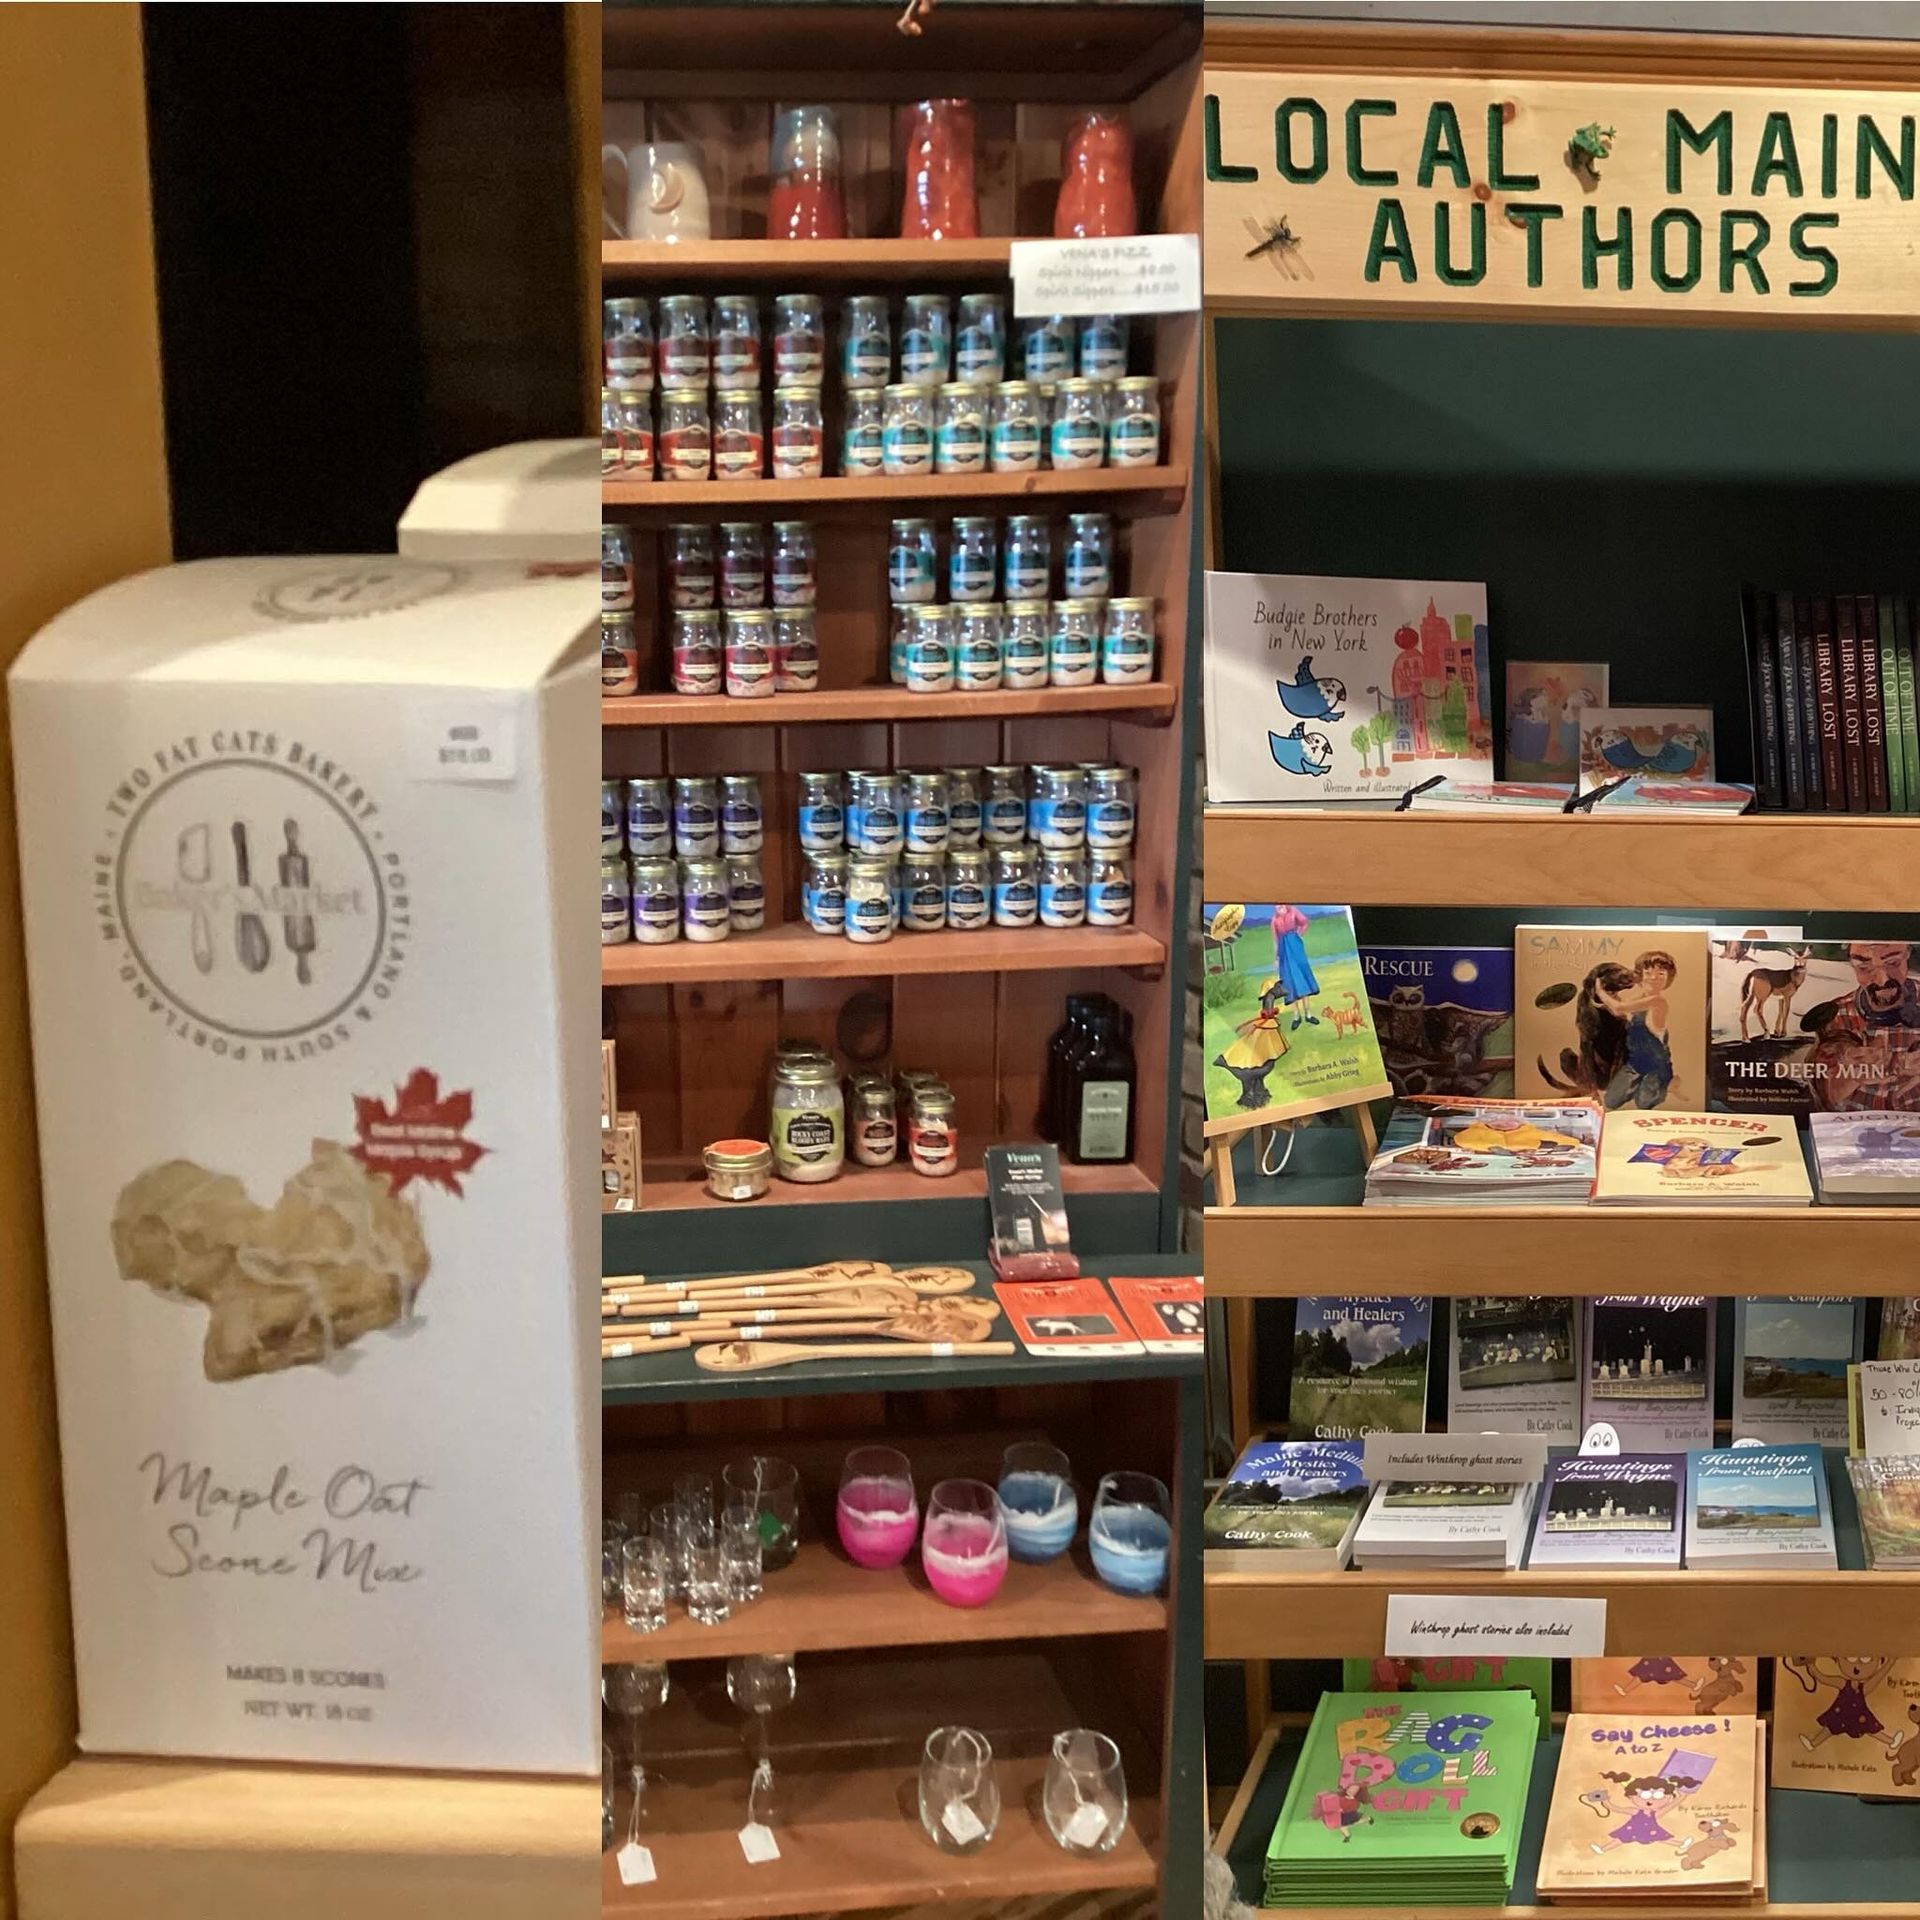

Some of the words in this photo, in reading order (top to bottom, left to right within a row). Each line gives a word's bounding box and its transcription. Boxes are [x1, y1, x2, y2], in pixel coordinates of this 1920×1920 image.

[1204, 94, 1540, 191] LOCAL
[1363, 198, 1840, 297] AUTHORS
[1253, 601, 1306, 631] Budgie
[1312, 604, 1378, 627] Brothers
[1268, 634, 1283, 651] in
[1291, 631, 1326, 652] New
[1333, 632, 1368, 652] York
[1817, 633, 1833, 697] LIBRARY
[1841, 639, 1858, 703] LIBRARY
[1862, 638, 1878, 702] LIBRARY
[1881, 648, 1896, 679] OUT
[1822, 703, 1838, 740] LOST
[1846, 708, 1860, 746] LOST
[1866, 707, 1881, 746] LOST
[1885, 705, 1899, 736] TIME
[105, 768, 151, 818] TWO
[154, 736, 198, 773] FAT
[212, 730, 276, 756] CATS
[288, 742, 379, 820] BAKERY
[1355, 782, 1371, 793] and
[1530, 935, 1625, 957] SAMMY
[1364, 955, 1434, 977] RESCUE
[261, 1023, 350, 1063] SOUTH
[1725, 1061, 1768, 1078] THE
[1774, 1062, 1829, 1079] DEER
[1836, 1063, 1885, 1079] MAN
[1632, 1116, 1769, 1133] SPENCER
[1832, 1114, 1920, 1122] AUGUS
[1322, 1307, 1349, 1321] and
[1353, 1307, 1406, 1321] Healers
[1895, 1364, 1911, 1373] Who
[1314, 1424, 1356, 1440] Cathy
[1537, 1419, 1556, 1432] Cathy
[1557, 1419, 1574, 1431] Cook
[1822, 1428, 1841, 1440] Cathy
[1245, 1449, 1302, 1470] Maine
[1282, 1459, 1337, 1470] Mystics
[1388, 1454, 1424, 1465] Includes
[1426, 1453, 1469, 1467] Winthrop
[1469, 1454, 1494, 1467] ghost
[1495, 1456, 1523, 1465] stories
[1557, 1460, 1674, 1474] Hauntings
[1698, 1453, 1808, 1467] Hauntings
[1261, 1469, 1290, 1477] and
[1294, 1469, 1348, 1478] Healers
[1555, 1472, 1601, 1483] from
[1603, 1470, 1672, 1483] Wayne
[1698, 1467, 1741, 1477] from
[1742, 1466, 1813, 1479] Eastport
[138, 1451, 307, 1532] Maple
[324, 1463, 435, 1520] Oat
[1225, 1530, 1273, 1541] Cathy
[1274, 1530, 1314, 1540] Cook
[152, 1522, 298, 1579] Scone
[302, 1527, 425, 1594] Mix
[1410, 1620, 1450, 1639] Winthrop
[1453, 1621, 1479, 1639] ghost
[1481, 1624, 1512, 1635] stories
[1514, 1622, 1533, 1635] also
[1535, 1622, 1573, 1636] included
[226, 1664, 288, 1685] MAKES
[1423, 1656, 1509, 1684] GIFT
[1336, 1710, 1494, 1760] RAG
[1591, 1727, 1633, 1744] Say
[1640, 1721, 1717, 1741] Cheese
[1615, 1744, 1627, 1756] A
[1631, 1743, 1648, 1754] to
[1650, 1743, 1664, 1753] Z
[1339, 1749, 1498, 1790] DOLL
[1371, 1787, 1469, 1813] GIFT
